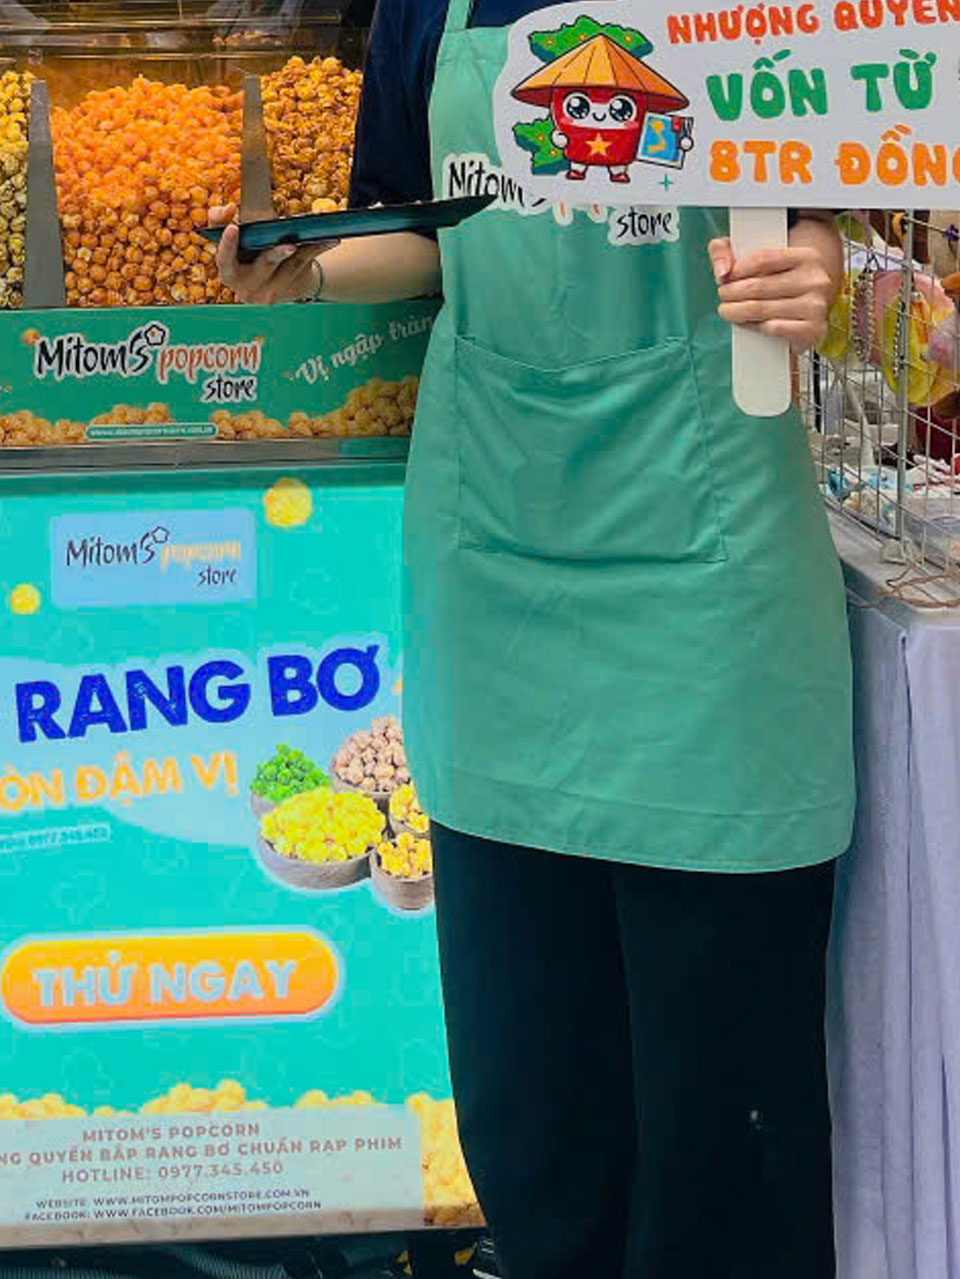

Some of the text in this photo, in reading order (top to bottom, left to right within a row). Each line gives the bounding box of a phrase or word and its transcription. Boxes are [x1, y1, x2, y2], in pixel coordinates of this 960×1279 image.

[667, 3, 820, 45] NHƯỢNG
[706, 49, 937, 120] VỐN TỪ
[709, 124, 960, 187] 8TR ĐỒN
[616, 207, 672, 239] store
[158, 340, 261, 384] popcorn
[203, 374, 258, 402] store
[198, 565, 237, 586] store
[15, 661, 251, 743] RANG
[268, 644, 381, 717] BƠ
[75, 751, 180, 808] ĐẬM
[190, 752, 239, 797] VỊ
[32, 949, 298, 1007] THỬ NGAY
[83, 1123, 260, 1143] MITOM'S POPCORN
[146, 1144, 197, 1160] RANG
[355, 1136, 403, 1150] PHIM
[62, 1160, 284, 1184] HOTLINE: 0977.345.450
